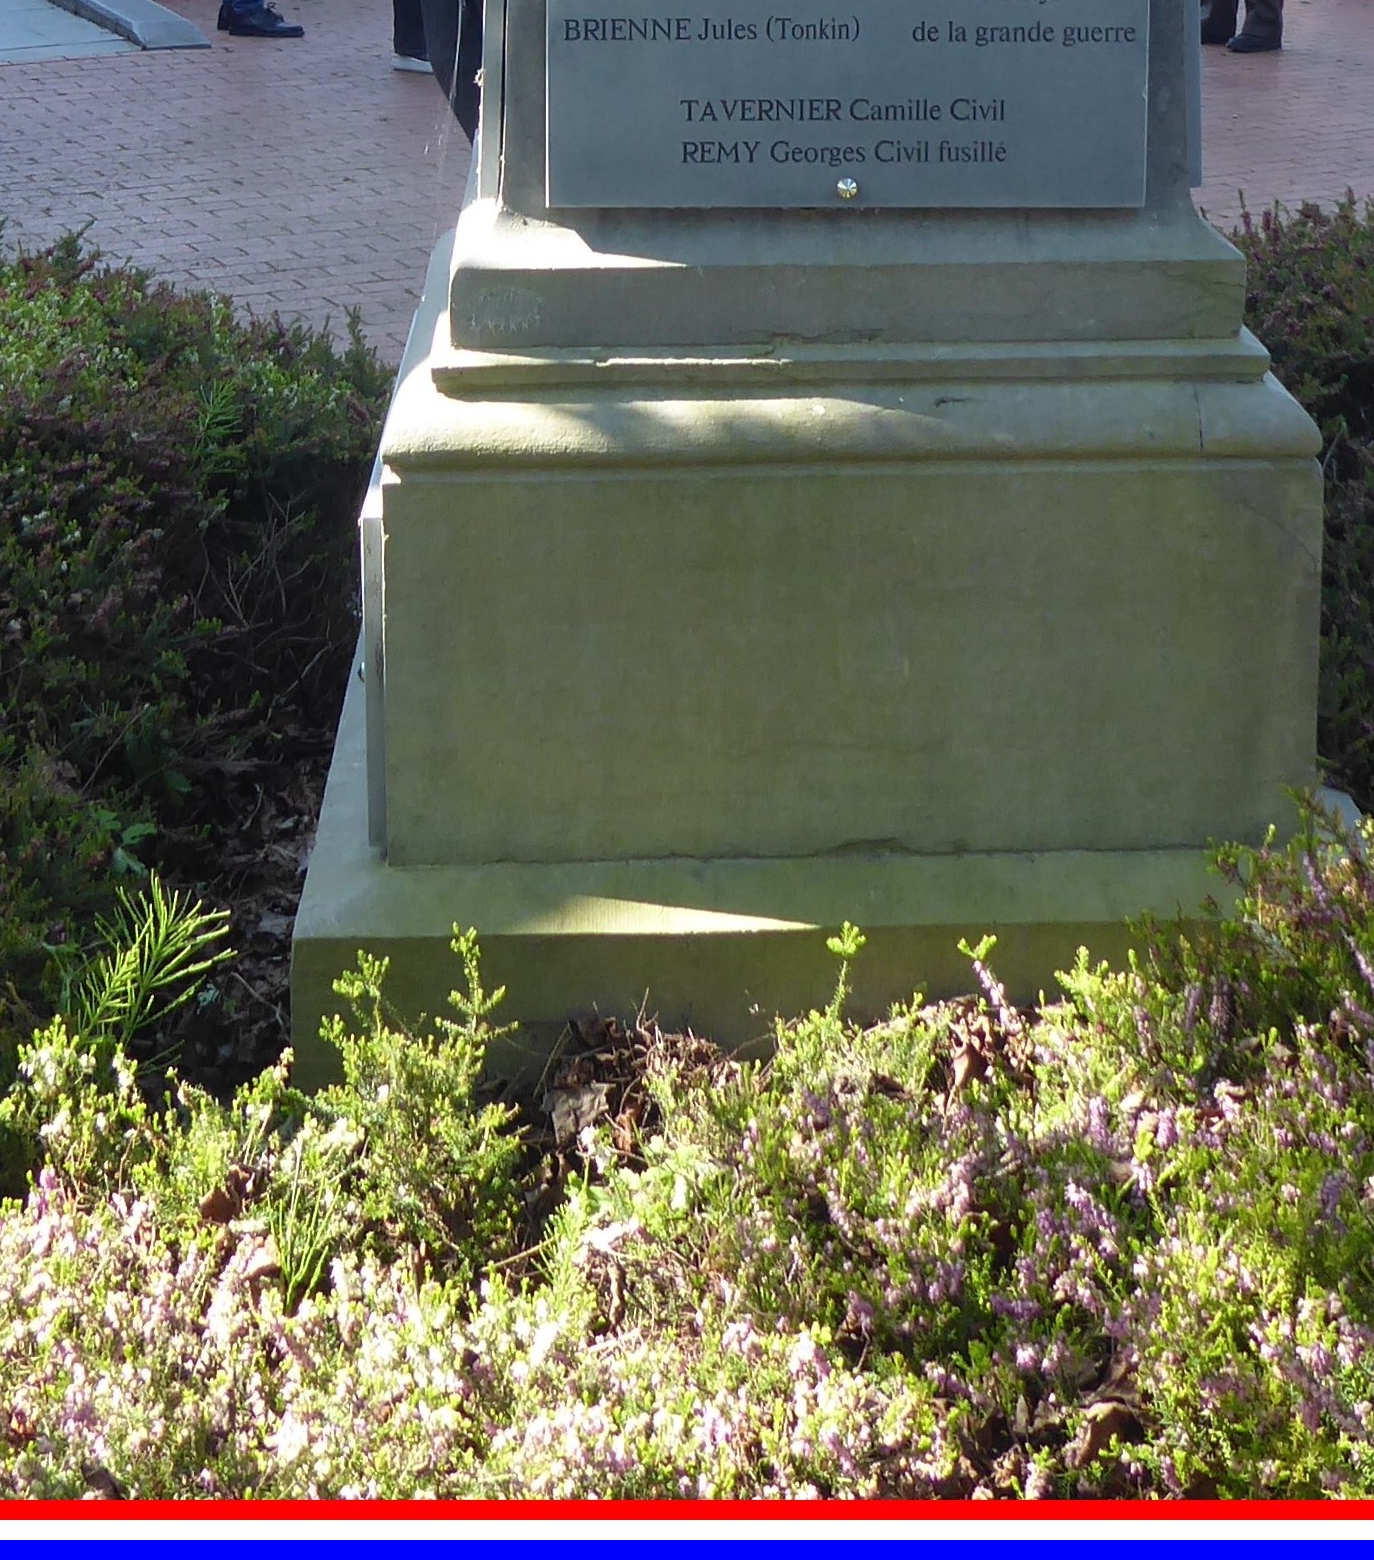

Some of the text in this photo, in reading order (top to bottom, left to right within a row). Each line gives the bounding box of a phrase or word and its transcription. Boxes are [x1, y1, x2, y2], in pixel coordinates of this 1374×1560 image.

[563, 15, 860, 43] BRIENNE Jules (Tonkin)
[912, 20, 1136, 48] de la grande guerre
[679, 98, 1005, 123] TAVERNIER Camille Civil
[681, 137, 1008, 168] REMY Georges Civil fusillé
